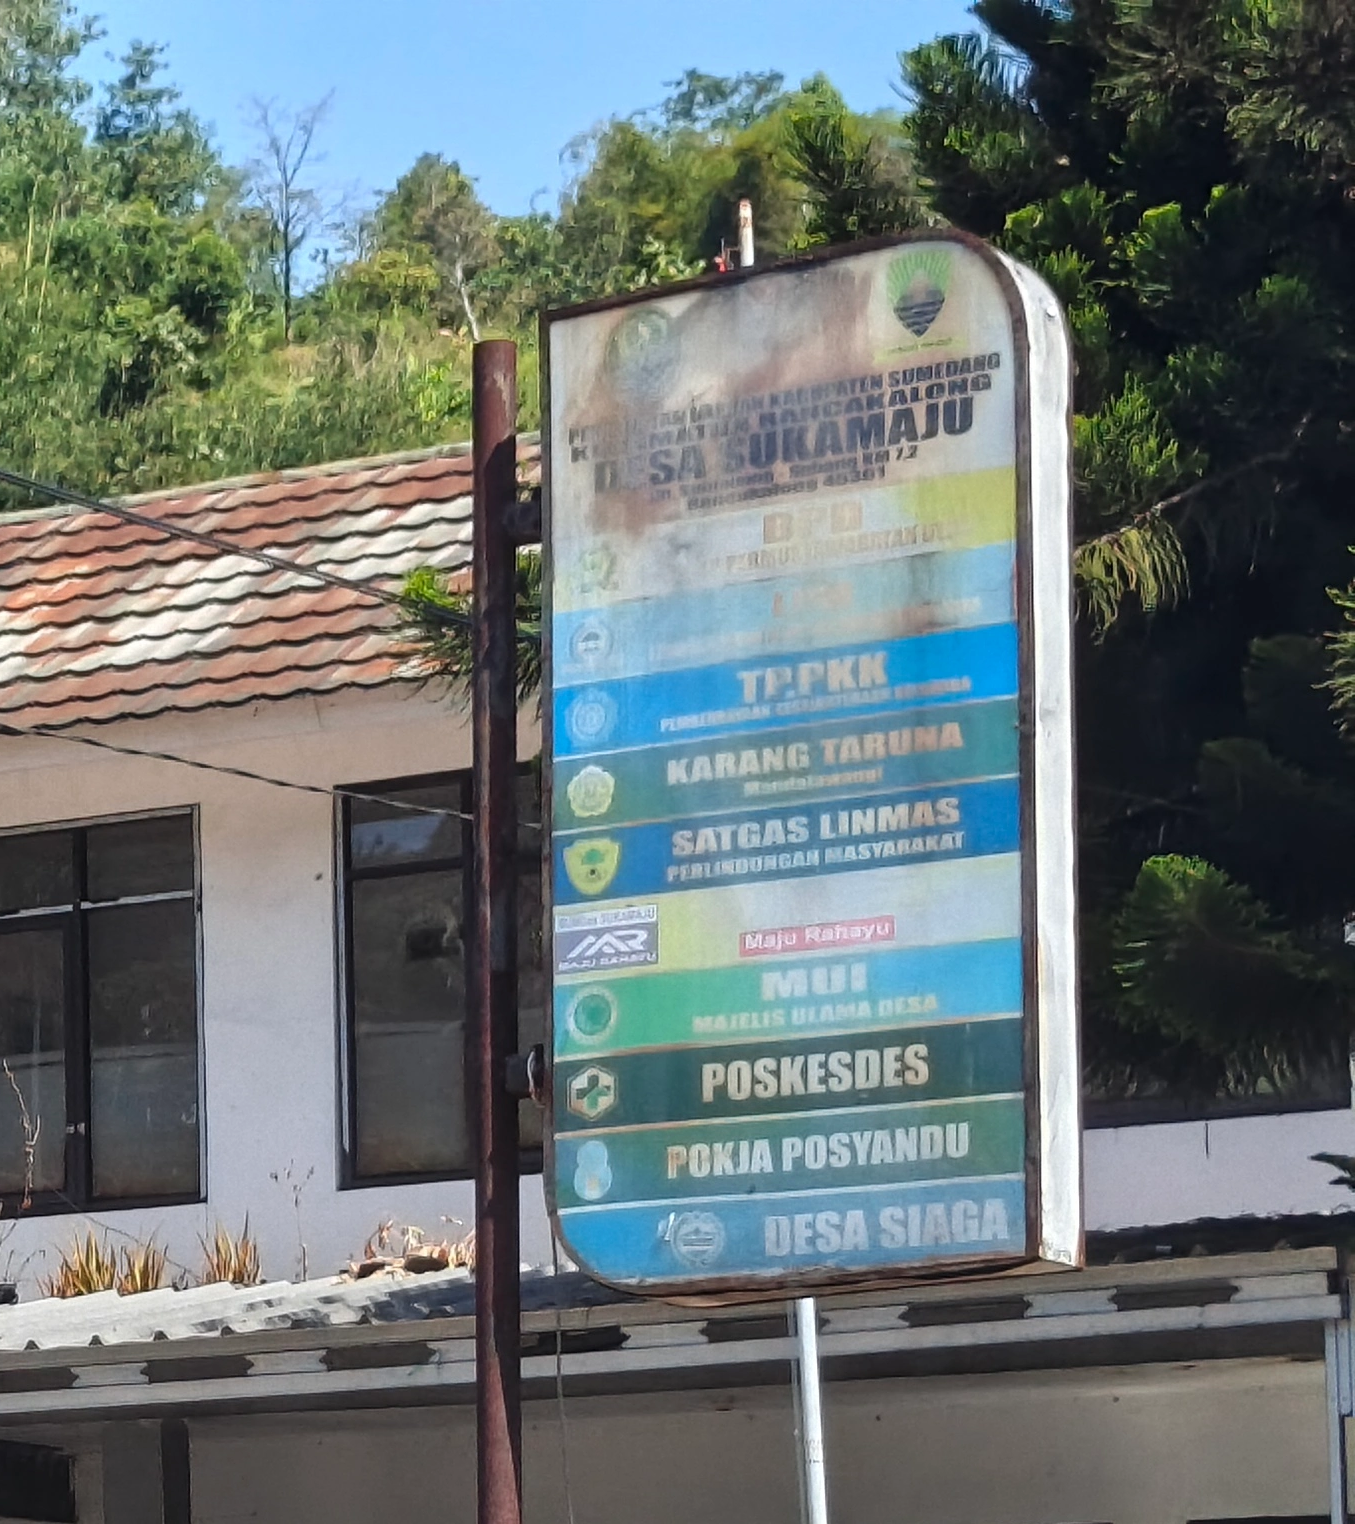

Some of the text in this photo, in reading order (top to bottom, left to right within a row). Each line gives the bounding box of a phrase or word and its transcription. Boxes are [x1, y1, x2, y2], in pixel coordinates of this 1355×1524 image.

[723, 396, 974, 475] SUKAMAJU
[667, 722, 963, 786] KARANG TARUNA
[671, 798, 961, 856] SATGAS LINMAS
[743, 919, 892, 951] Maju Rahayu
[761, 962, 868, 1001] MUI
[791, 1000, 872, 1026] ULAMA
[878, 993, 939, 1017] DESA
[701, 1043, 930, 1103] POSKESDES
[667, 1121, 971, 1179] POKJA POSYANDU
[764, 1198, 1011, 1257] DESA SIAGA
